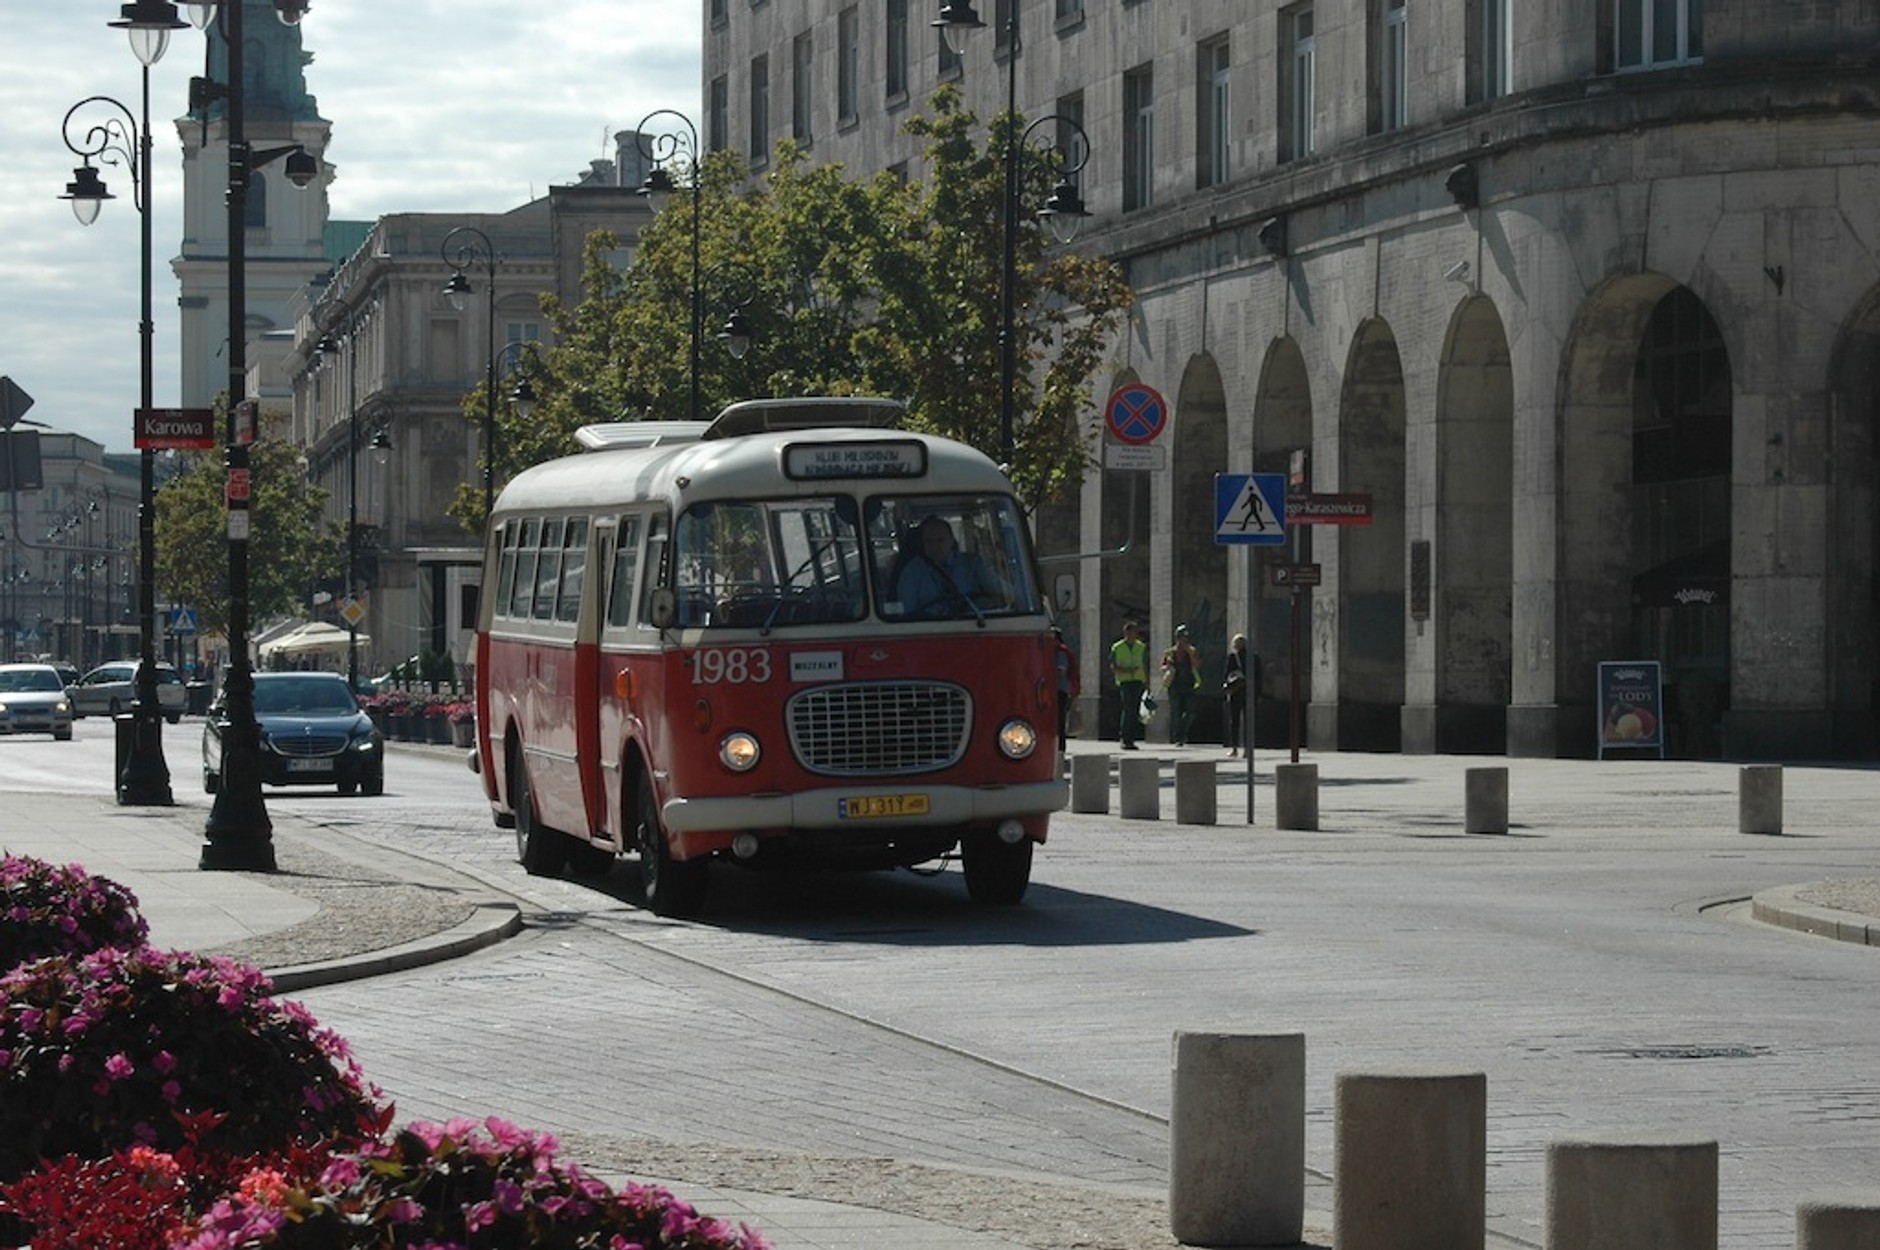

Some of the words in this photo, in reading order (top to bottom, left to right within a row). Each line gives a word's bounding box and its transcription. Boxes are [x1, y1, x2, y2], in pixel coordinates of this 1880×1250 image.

[145, 418, 204, 436] Karowa
[692, 648, 772, 684] 1983
[1618, 691, 1653, 702] LODY
